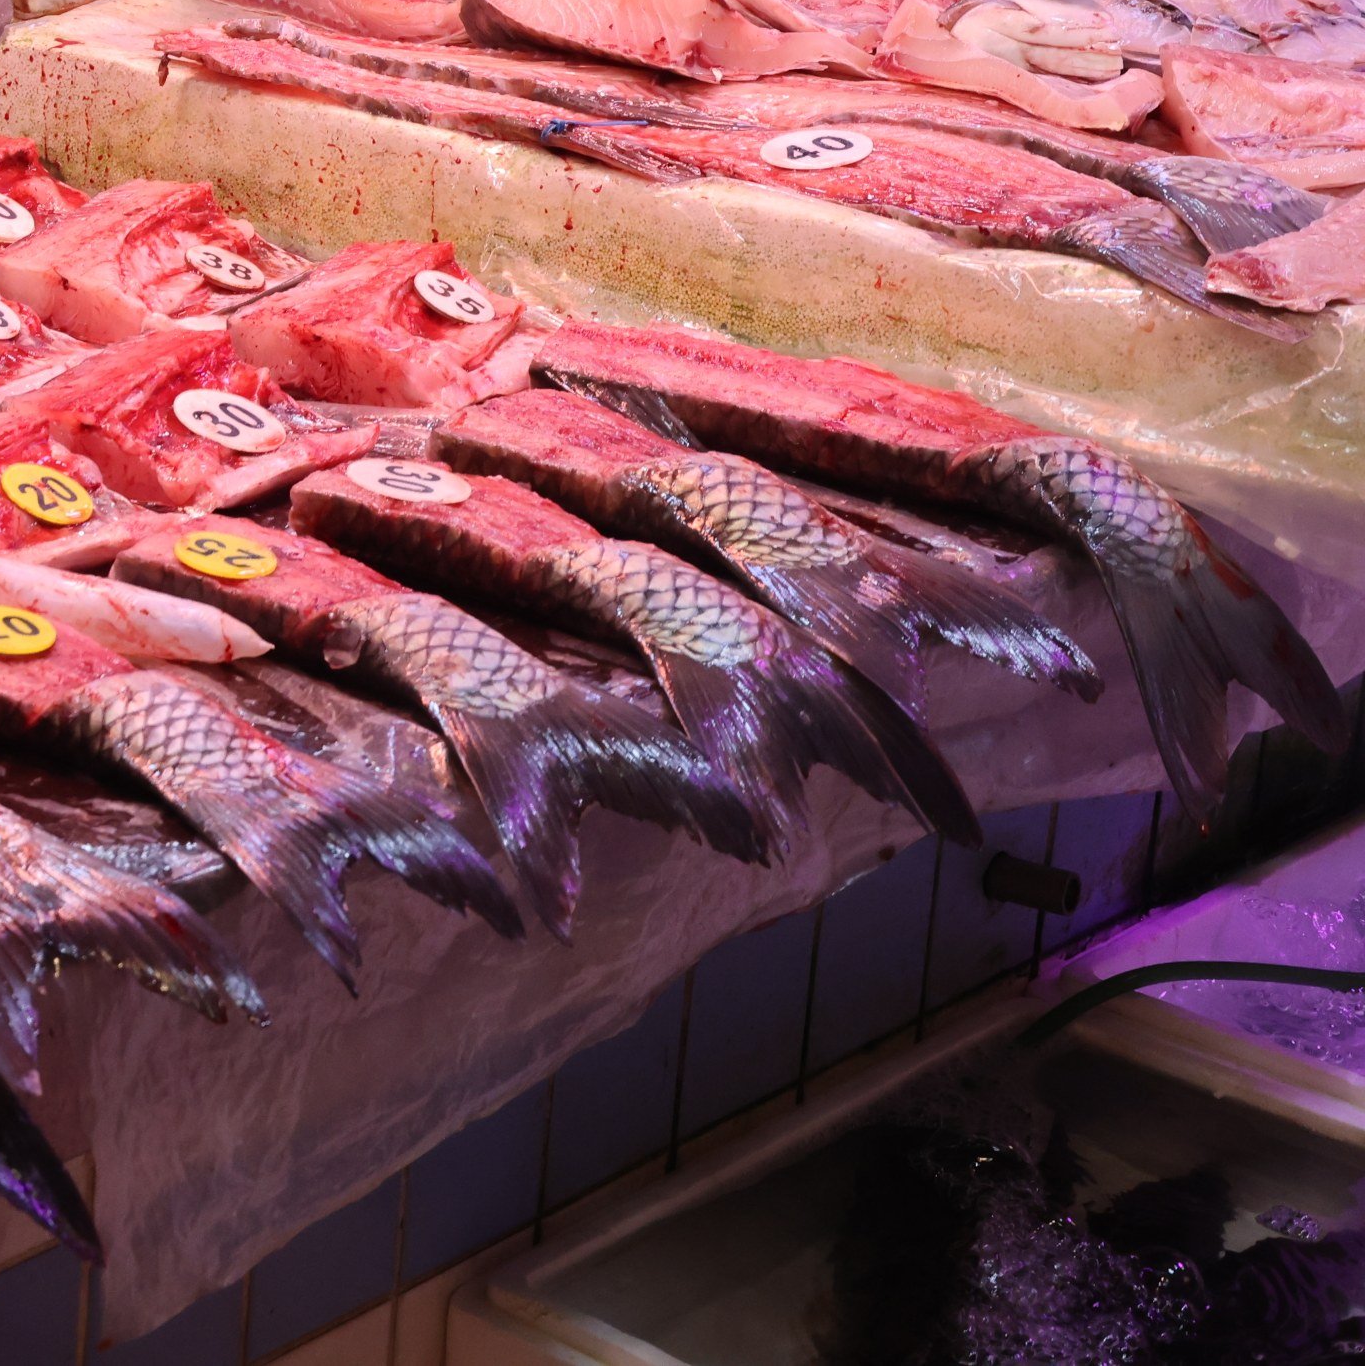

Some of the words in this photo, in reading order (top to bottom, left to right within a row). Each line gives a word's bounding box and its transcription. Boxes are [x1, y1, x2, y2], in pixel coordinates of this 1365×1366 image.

[787, 137, 854, 160] 40
[200, 251, 253, 280] 38
[426, 278, 485, 317] 35
[192, 402, 264, 438] 30
[16, 476, 78, 513] 20
[378, 465, 441, 495] 30
[185, 538, 266, 569] 25
